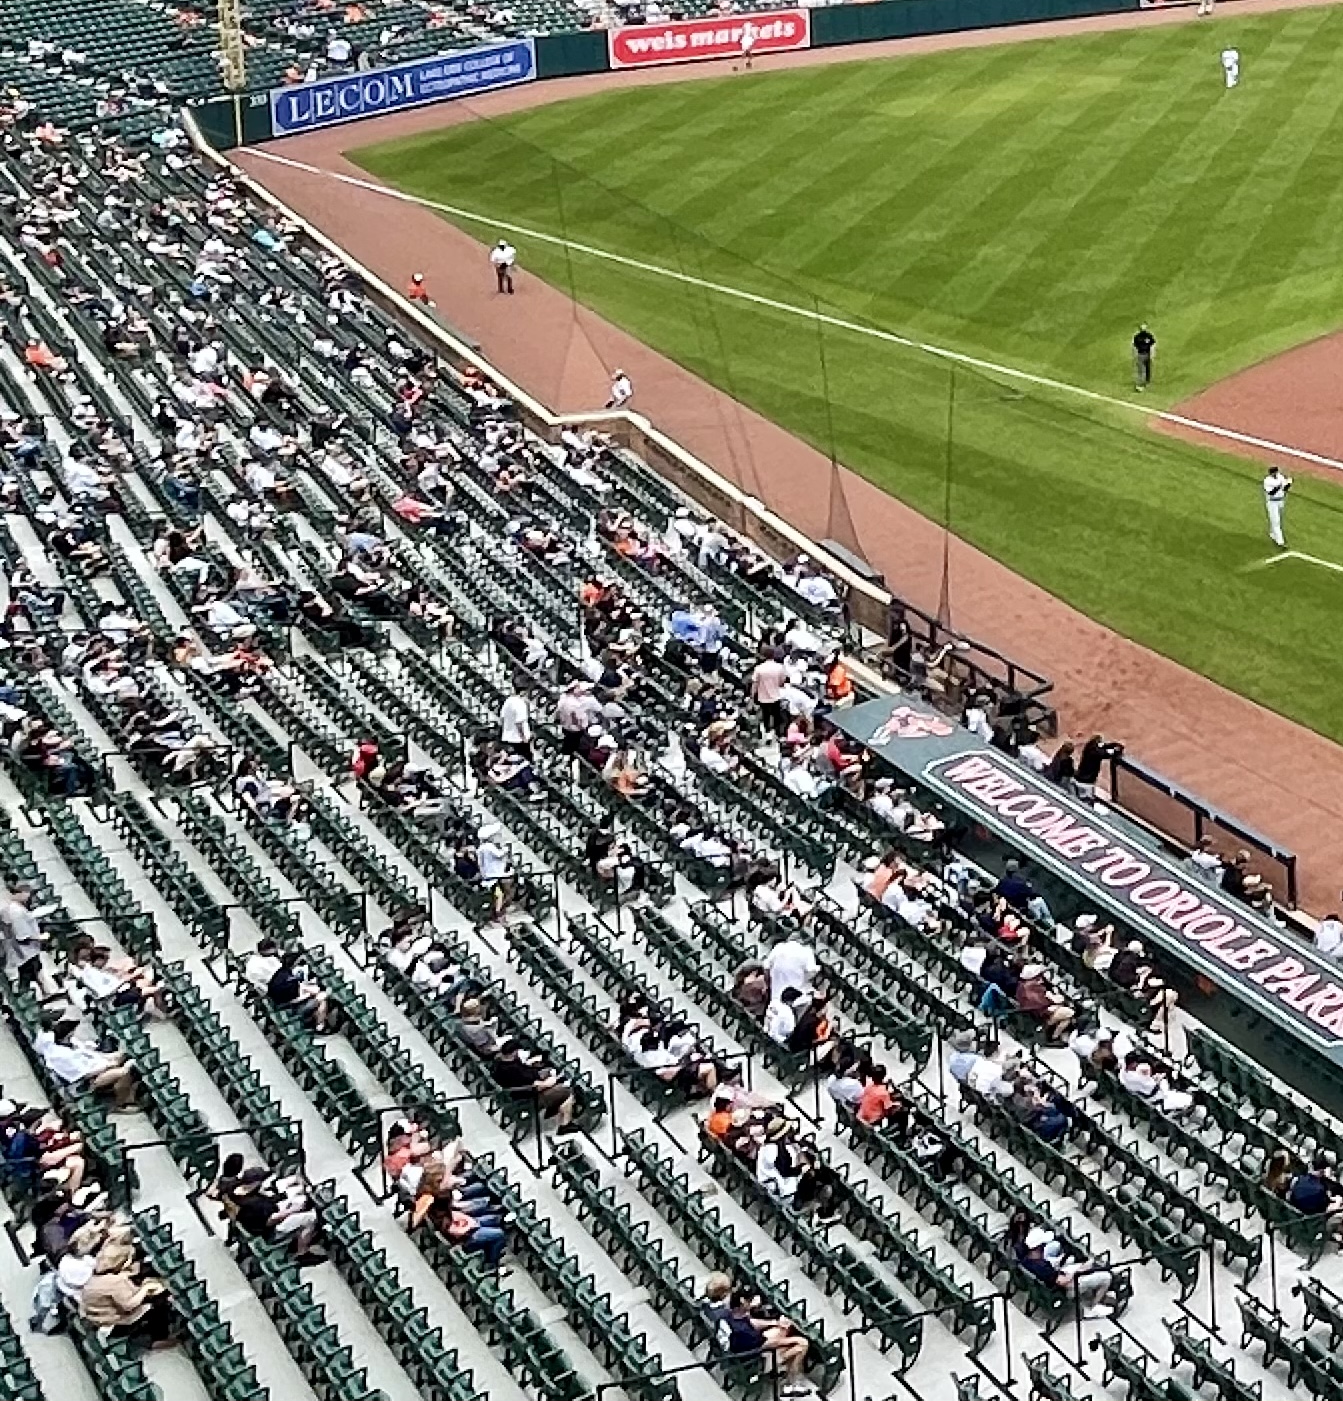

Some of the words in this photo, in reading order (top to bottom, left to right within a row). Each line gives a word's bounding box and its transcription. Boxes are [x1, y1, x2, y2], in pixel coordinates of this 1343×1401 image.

[625, 30, 687, 54] weis
[689, 20, 796, 48] markets
[287, 72, 414, 123] LECOM
[942, 754, 1103, 861] WELCOME
[1080, 846, 1151, 890] TO
[1128, 877, 1266, 972] ORIOLE
